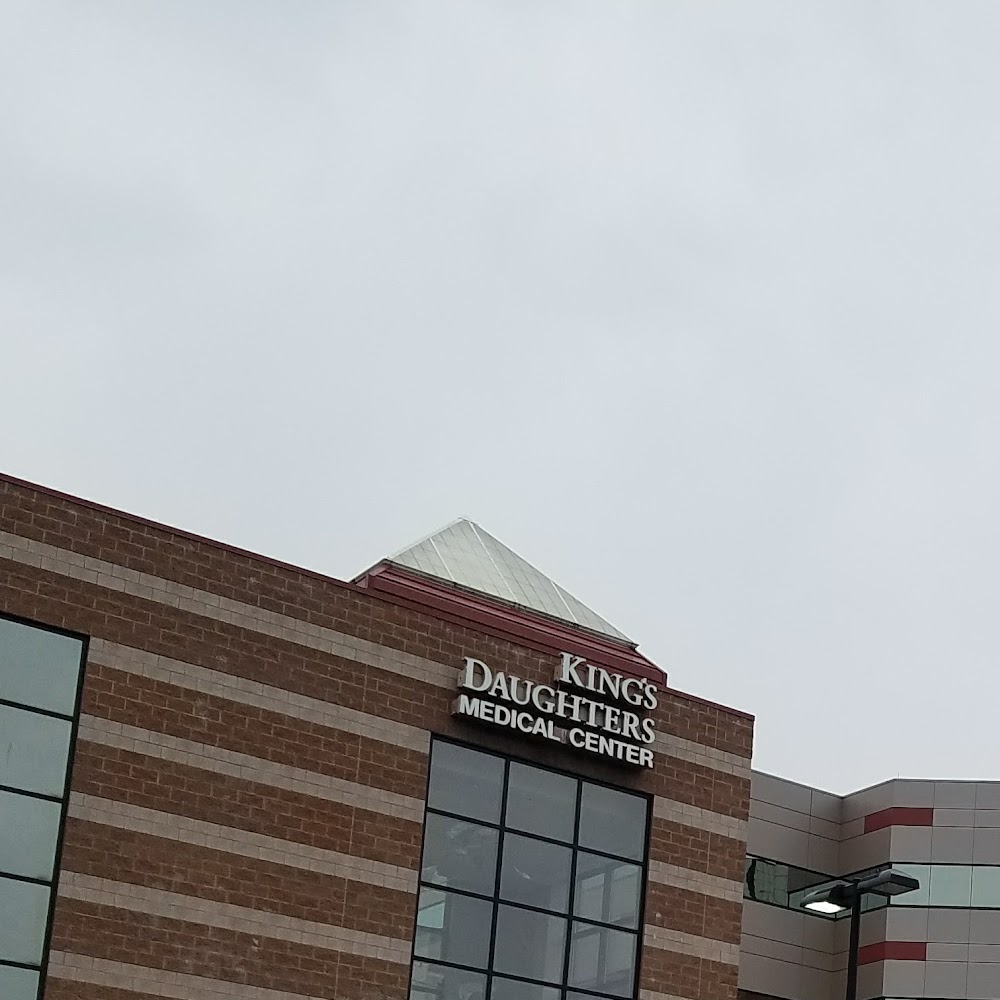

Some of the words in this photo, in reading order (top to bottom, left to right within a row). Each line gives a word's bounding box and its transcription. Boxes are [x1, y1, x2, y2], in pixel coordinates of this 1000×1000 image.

[459, 694, 561, 742] MEDICAL
[569, 727, 654, 769] CENTER
[462, 656, 656, 744] DAUGHTERS
